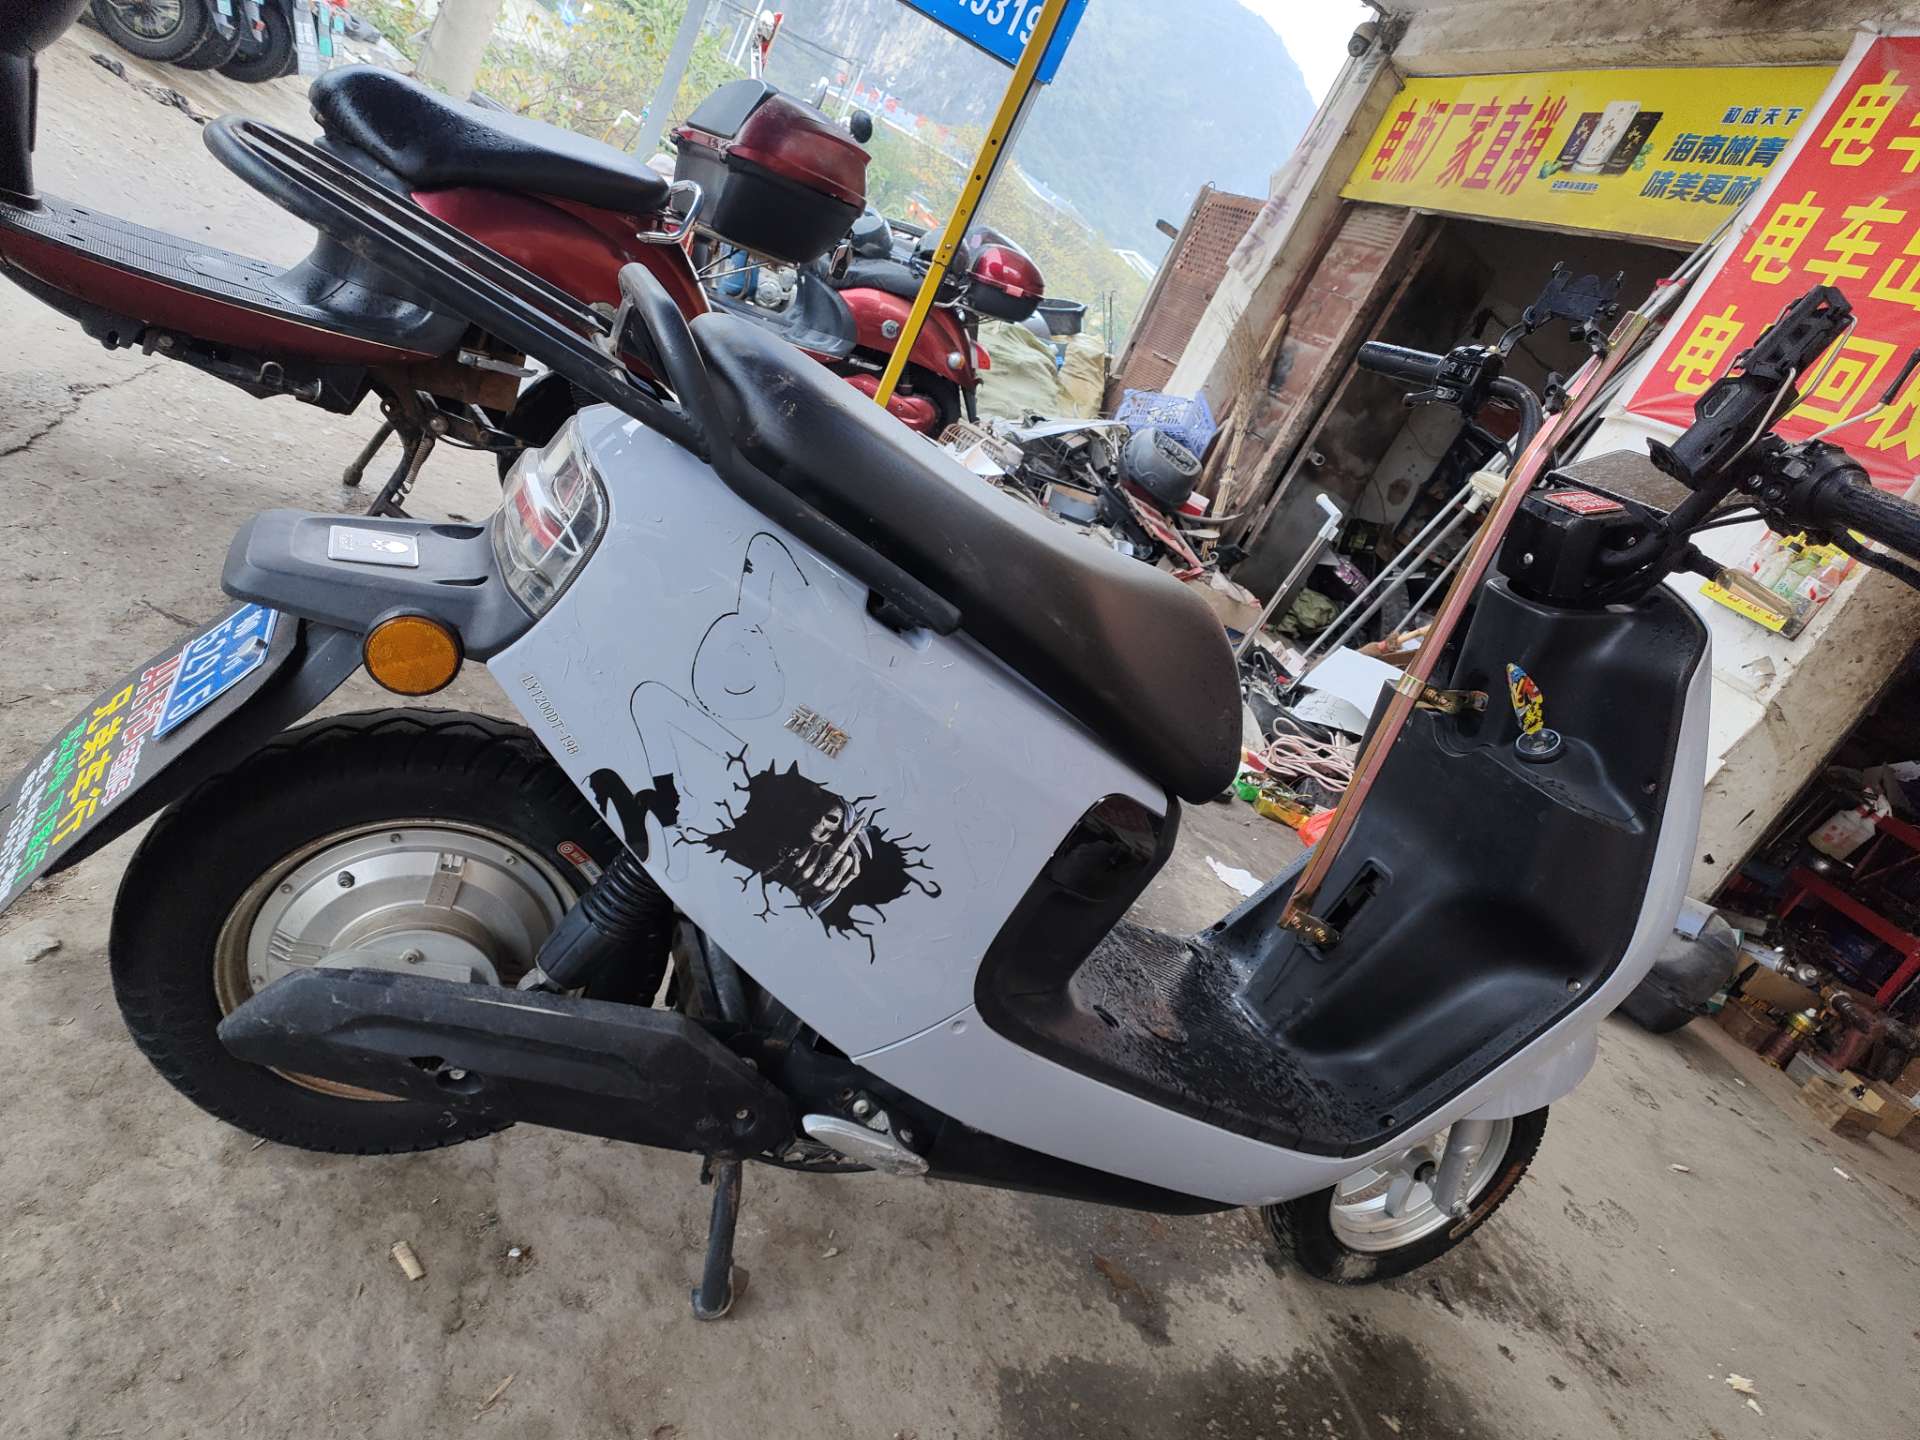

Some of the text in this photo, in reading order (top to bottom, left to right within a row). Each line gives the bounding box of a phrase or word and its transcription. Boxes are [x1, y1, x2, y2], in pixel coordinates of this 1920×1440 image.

[1370, 96, 1568, 195] 电瓶厂家直销
[1722, 106, 1804, 125] 和成天下
[172, 622, 234, 721] 52915
[51, 683, 134, 846] 兄弟车行
